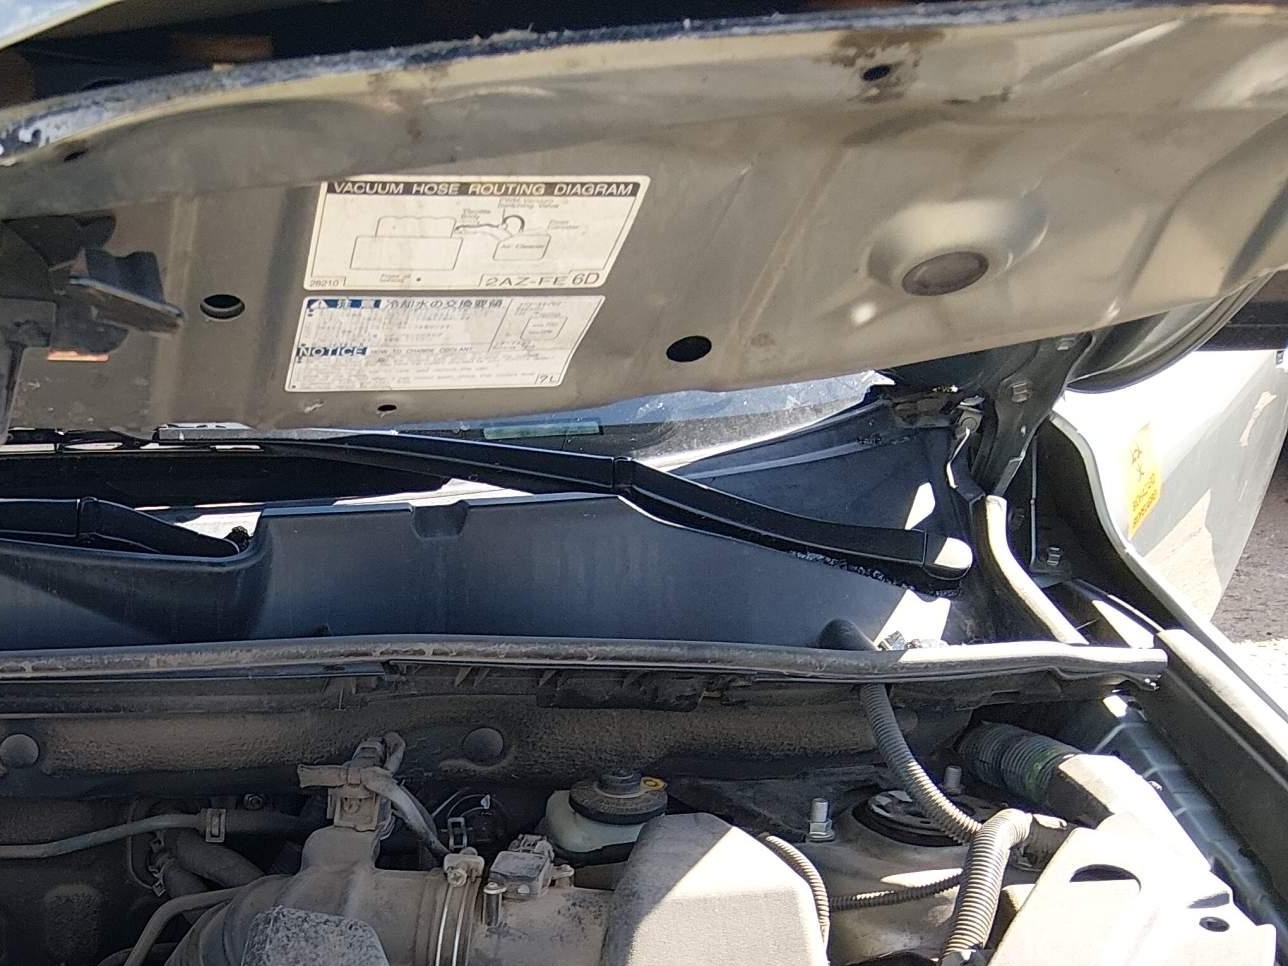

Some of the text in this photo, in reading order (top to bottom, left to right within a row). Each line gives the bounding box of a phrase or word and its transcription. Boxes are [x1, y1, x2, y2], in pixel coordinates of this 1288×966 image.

[332, 182, 635, 196] VACUUM HOSE ROUTING DIAGRAM
[485, 272, 600, 286] 2AZ-FE 6D
[297, 346, 367, 357] NOTICE
